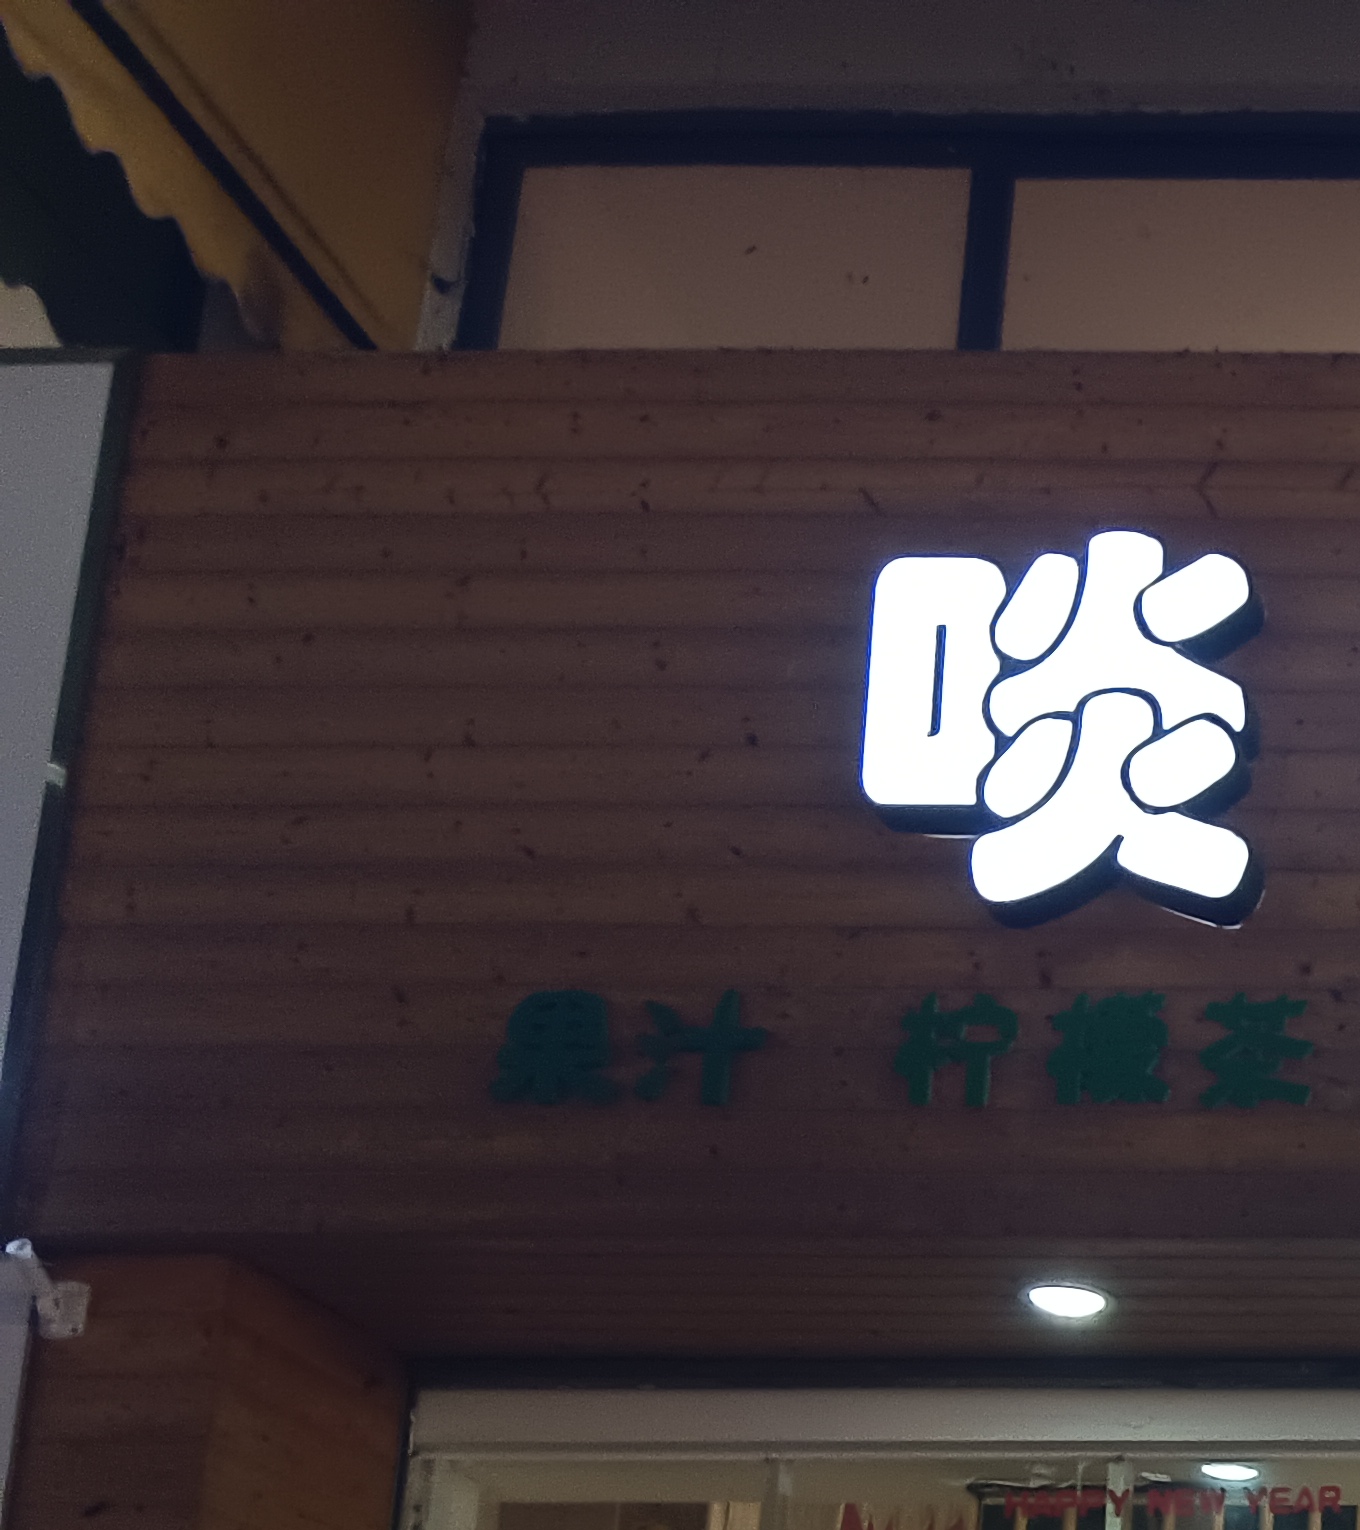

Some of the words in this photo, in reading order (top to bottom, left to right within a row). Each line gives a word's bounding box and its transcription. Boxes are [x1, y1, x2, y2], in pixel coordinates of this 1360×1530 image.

[487, 985, 770, 1107] 果汁
[894, 991, 1314, 1108] 柠檬茶
[1004, 1488, 1131, 1518] HAPPY
[1146, 1487, 1227, 1517] NEW
[1246, 1485, 1342, 1515] YEAR
